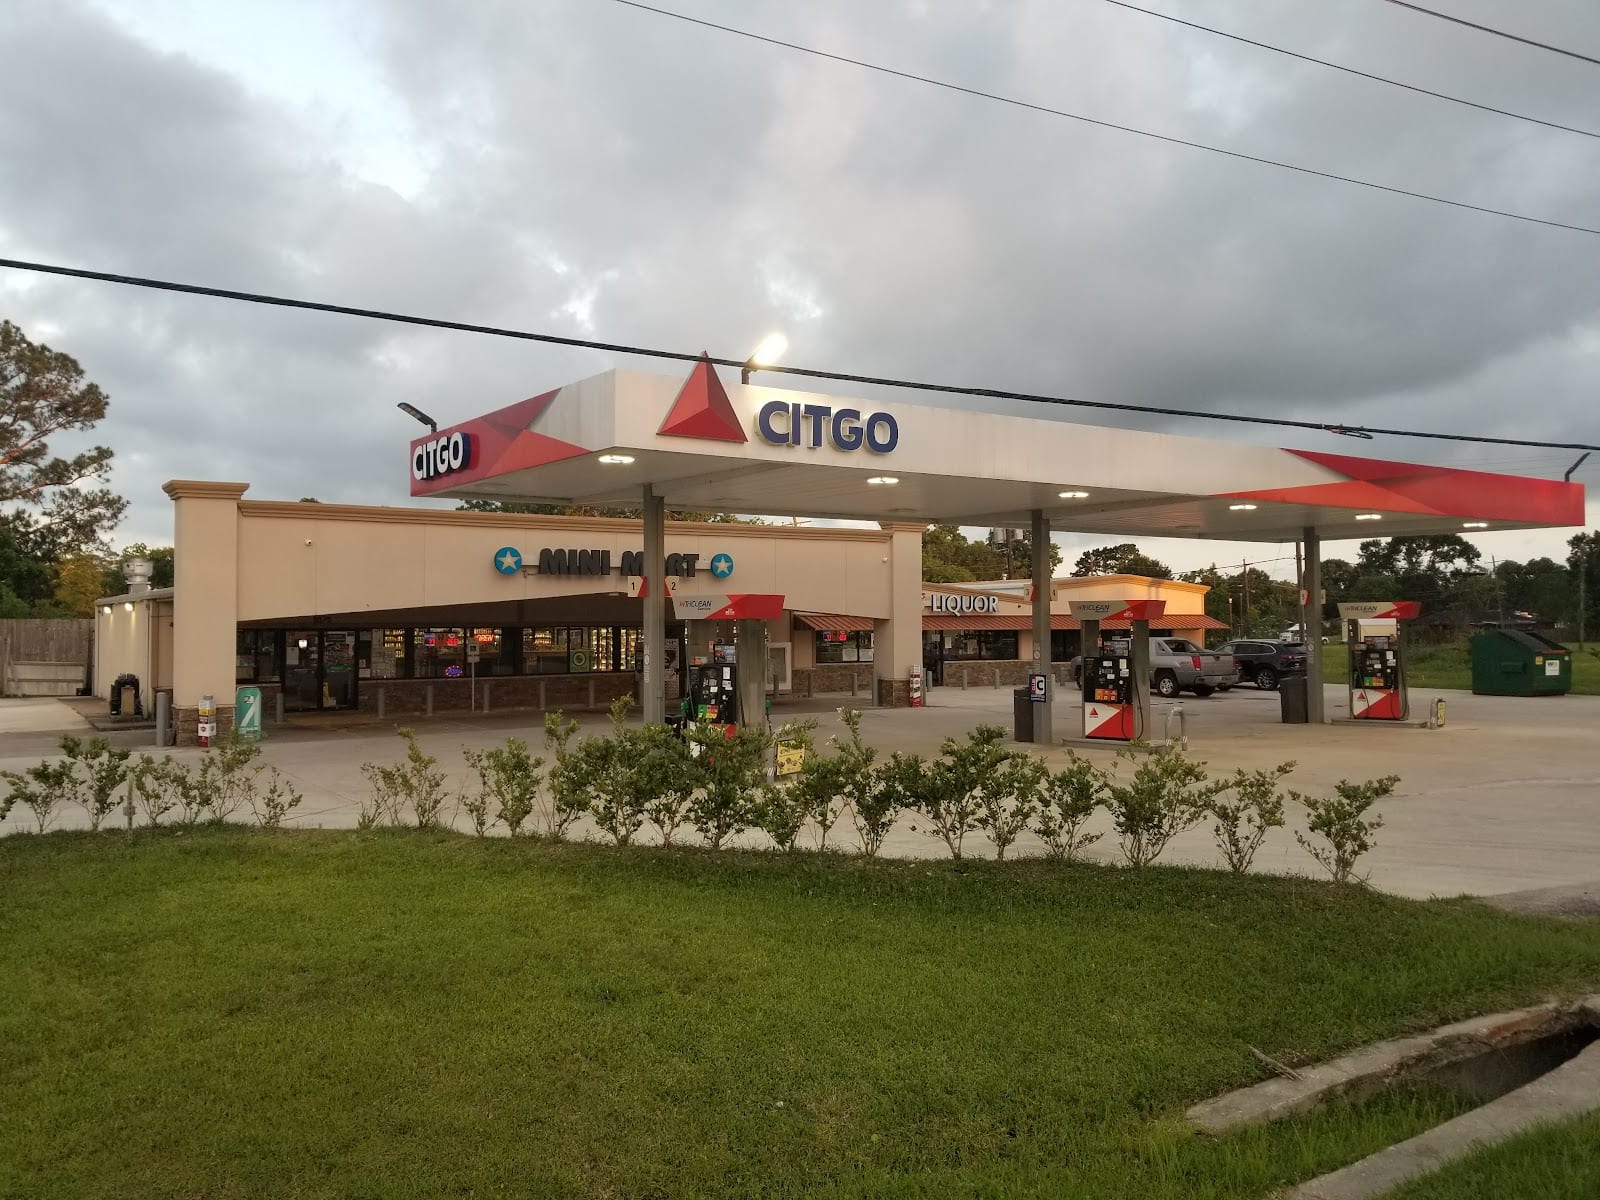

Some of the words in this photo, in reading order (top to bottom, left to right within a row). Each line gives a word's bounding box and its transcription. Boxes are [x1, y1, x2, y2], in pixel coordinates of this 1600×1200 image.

[758, 400, 899, 455] CITGO
[412, 431, 464, 481] CITGO
[539, 548, 611, 576] MINI
[620, 550, 700, 578] MRT
[630, 581, 636, 591] 1
[670, 581, 676, 591] 2
[931, 594, 999, 616] LIQUOR
